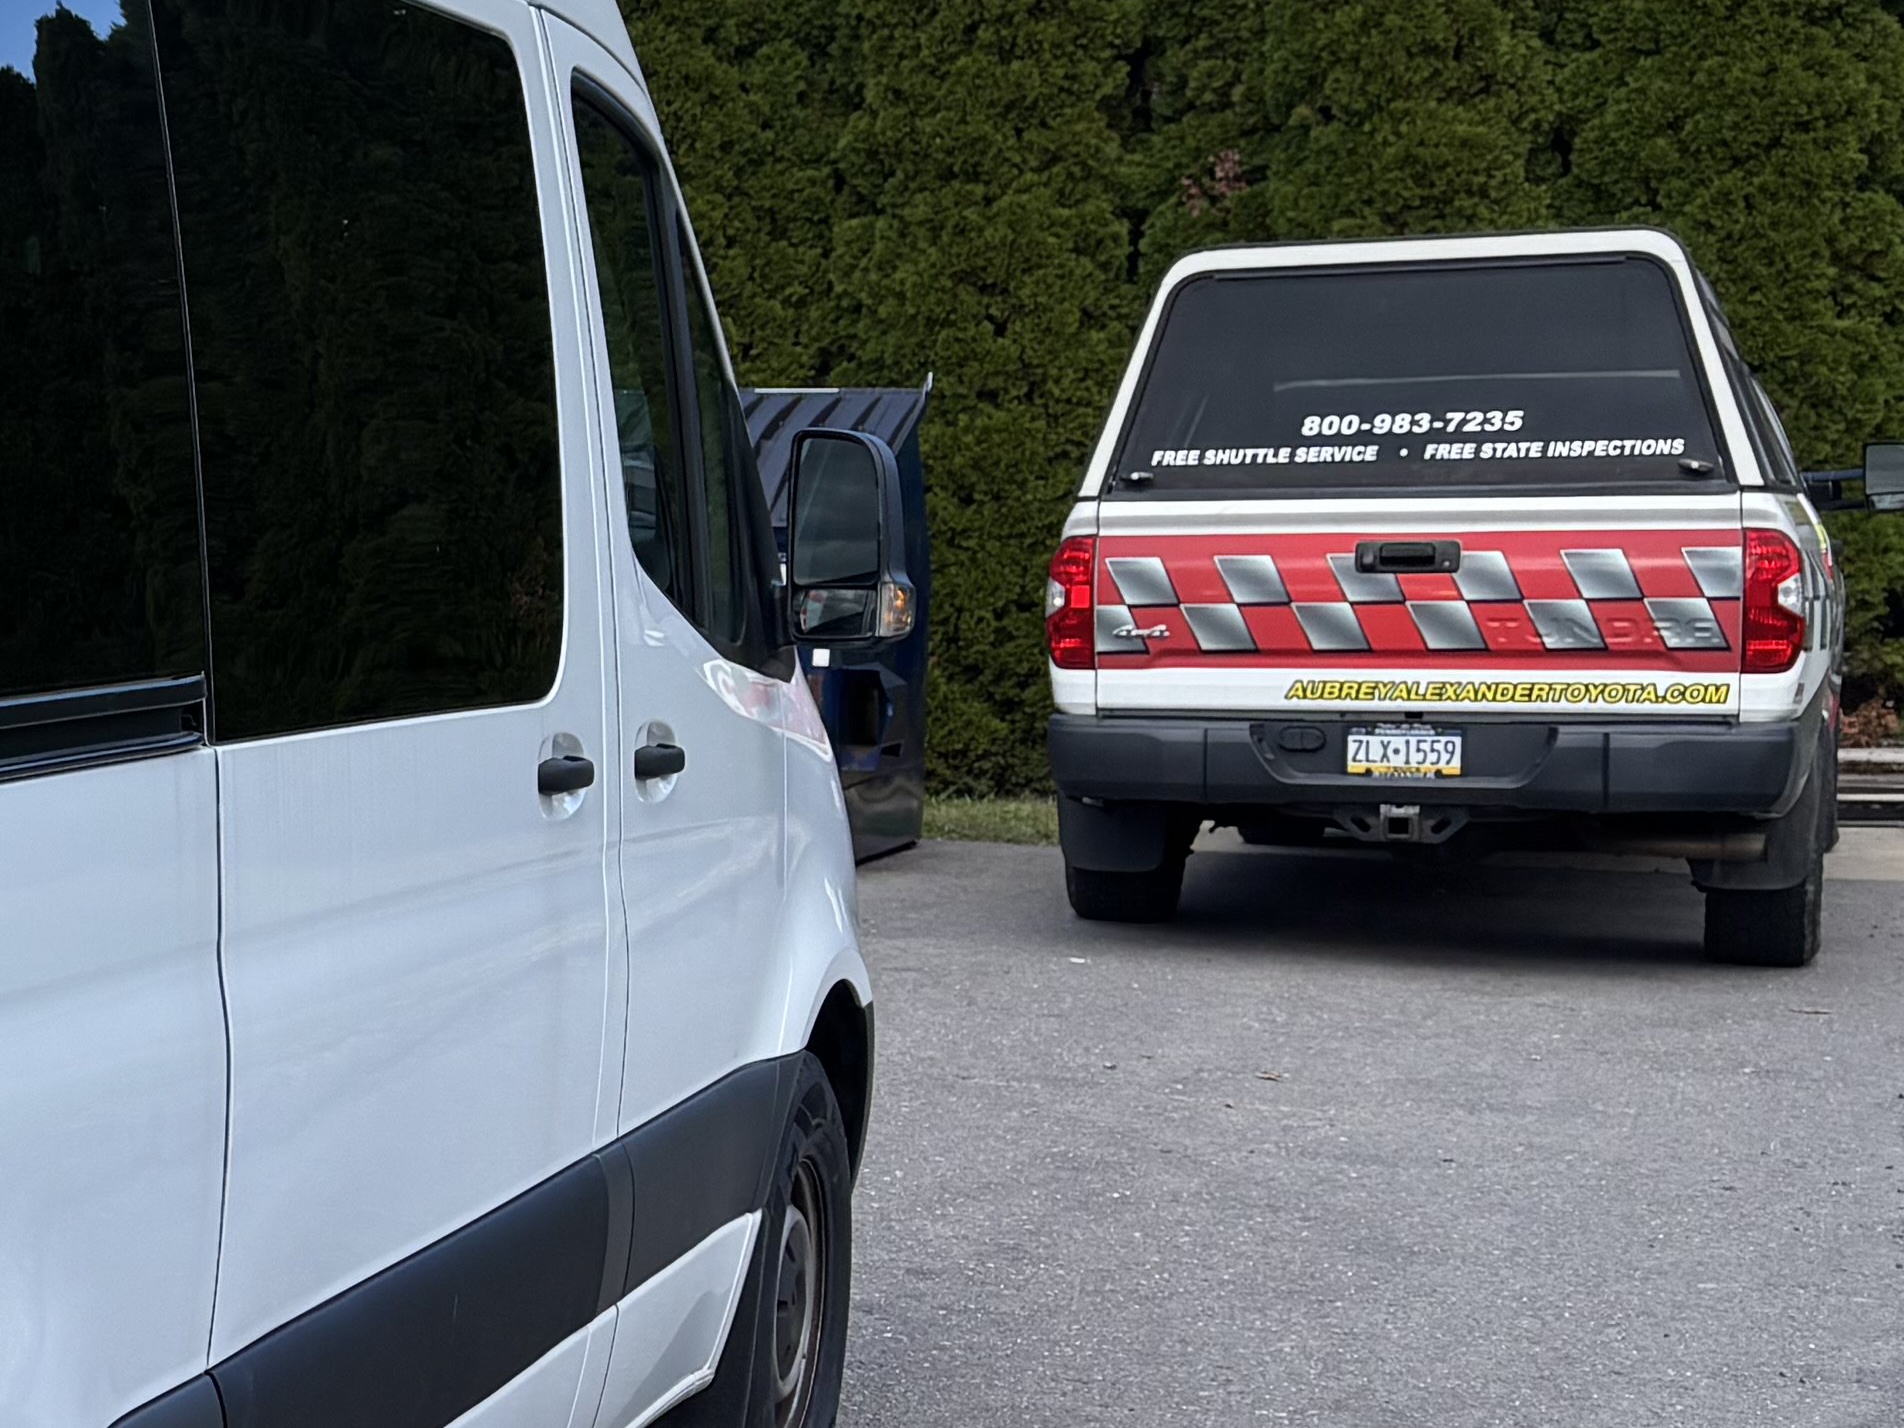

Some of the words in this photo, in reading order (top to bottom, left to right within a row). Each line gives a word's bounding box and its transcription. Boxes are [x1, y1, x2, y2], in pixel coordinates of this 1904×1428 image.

[1301, 410, 1524, 437] 800-983-7235
[1151, 449, 1200, 466] FREE
[1202, 447, 1291, 465] SHUTTLE
[1294, 445, 1379, 463] SERVICE
[1423, 443, 1476, 460] FREE
[1479, 441, 1544, 459] STATE
[1547, 438, 1685, 458] INSPECTIONS
[1486, 617, 1723, 645] TUNDRA
[1285, 680, 1730, 704] AUBREYALEXANDERTOYOTA.COM
